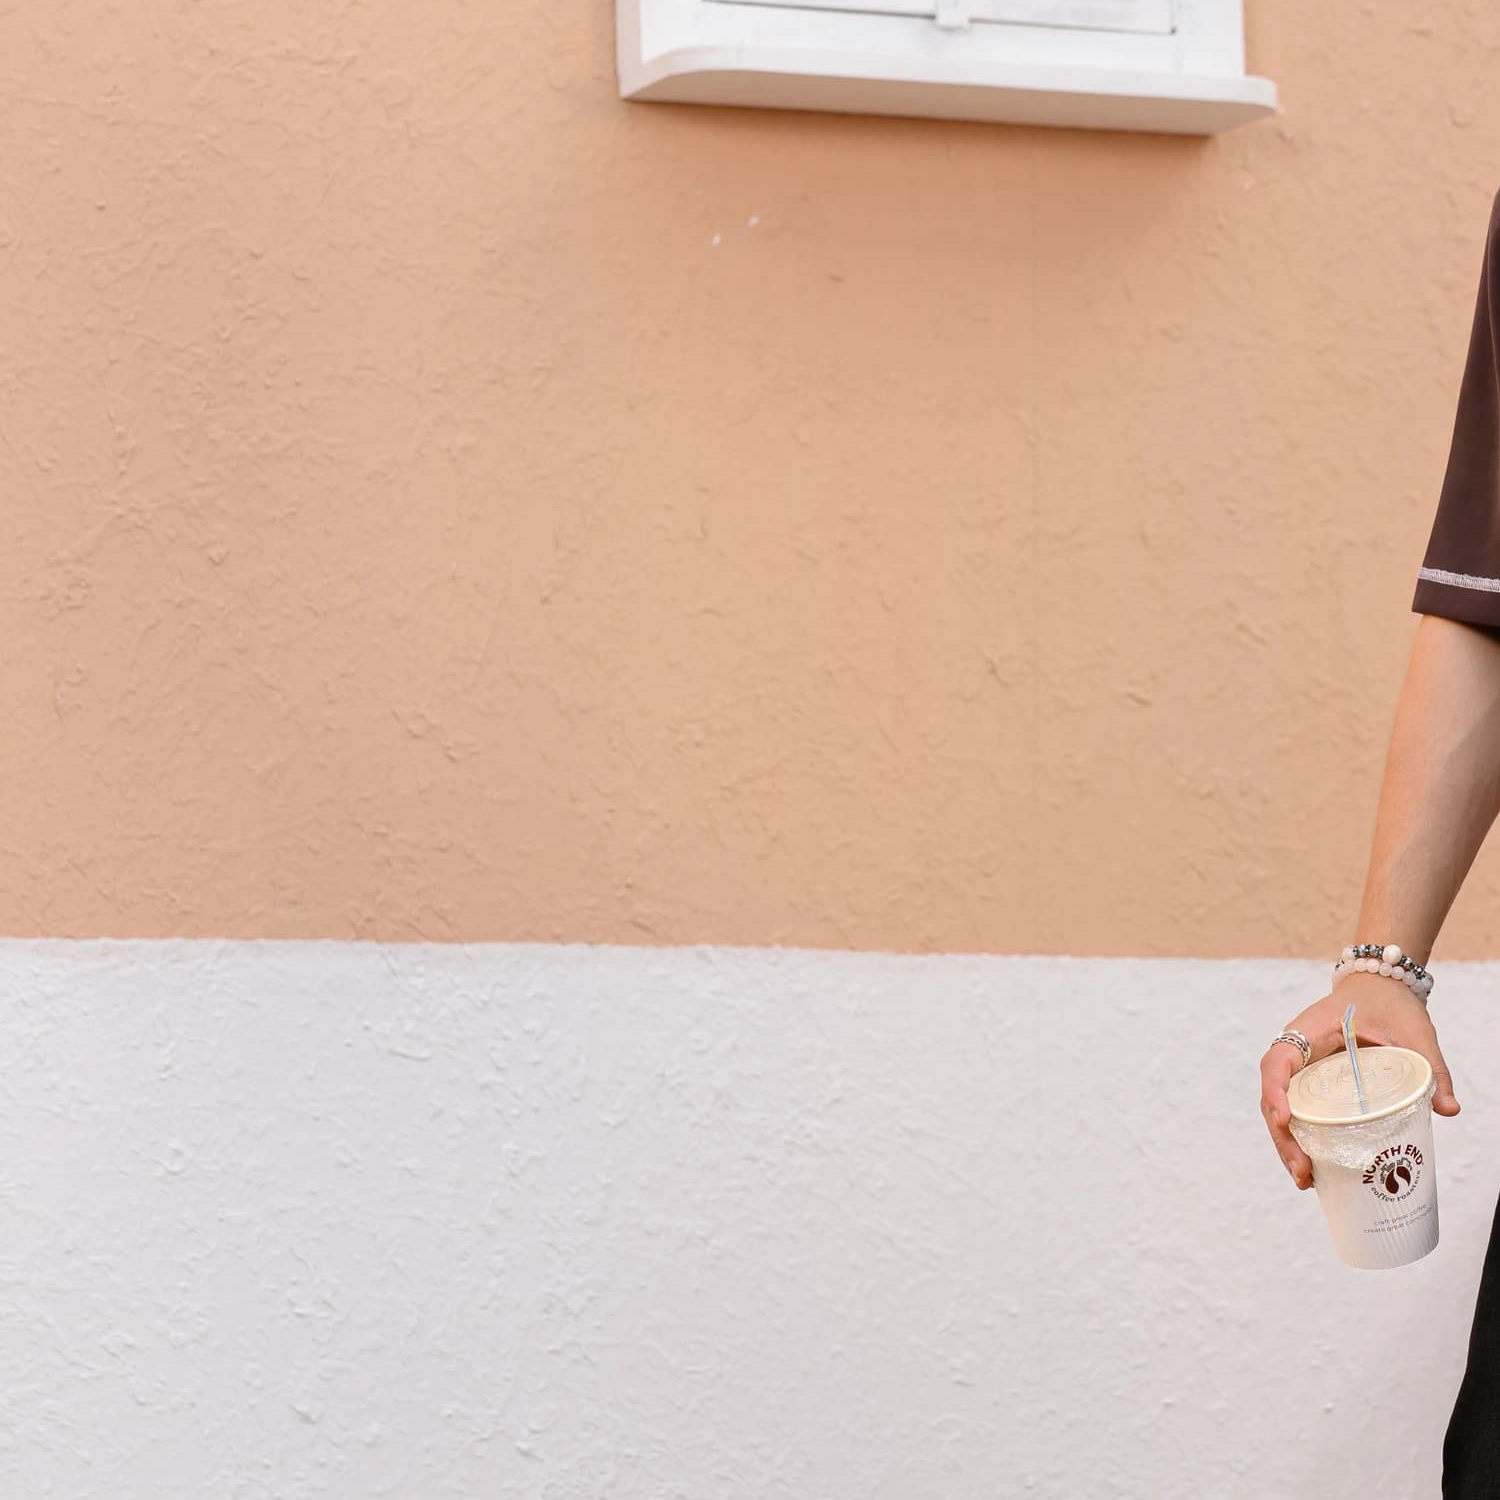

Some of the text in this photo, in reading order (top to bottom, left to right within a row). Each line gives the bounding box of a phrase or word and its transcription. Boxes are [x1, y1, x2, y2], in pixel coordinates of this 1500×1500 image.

[1362, 1143, 1424, 1185] NORTH END
[1370, 1186, 1396, 1203] coffee
